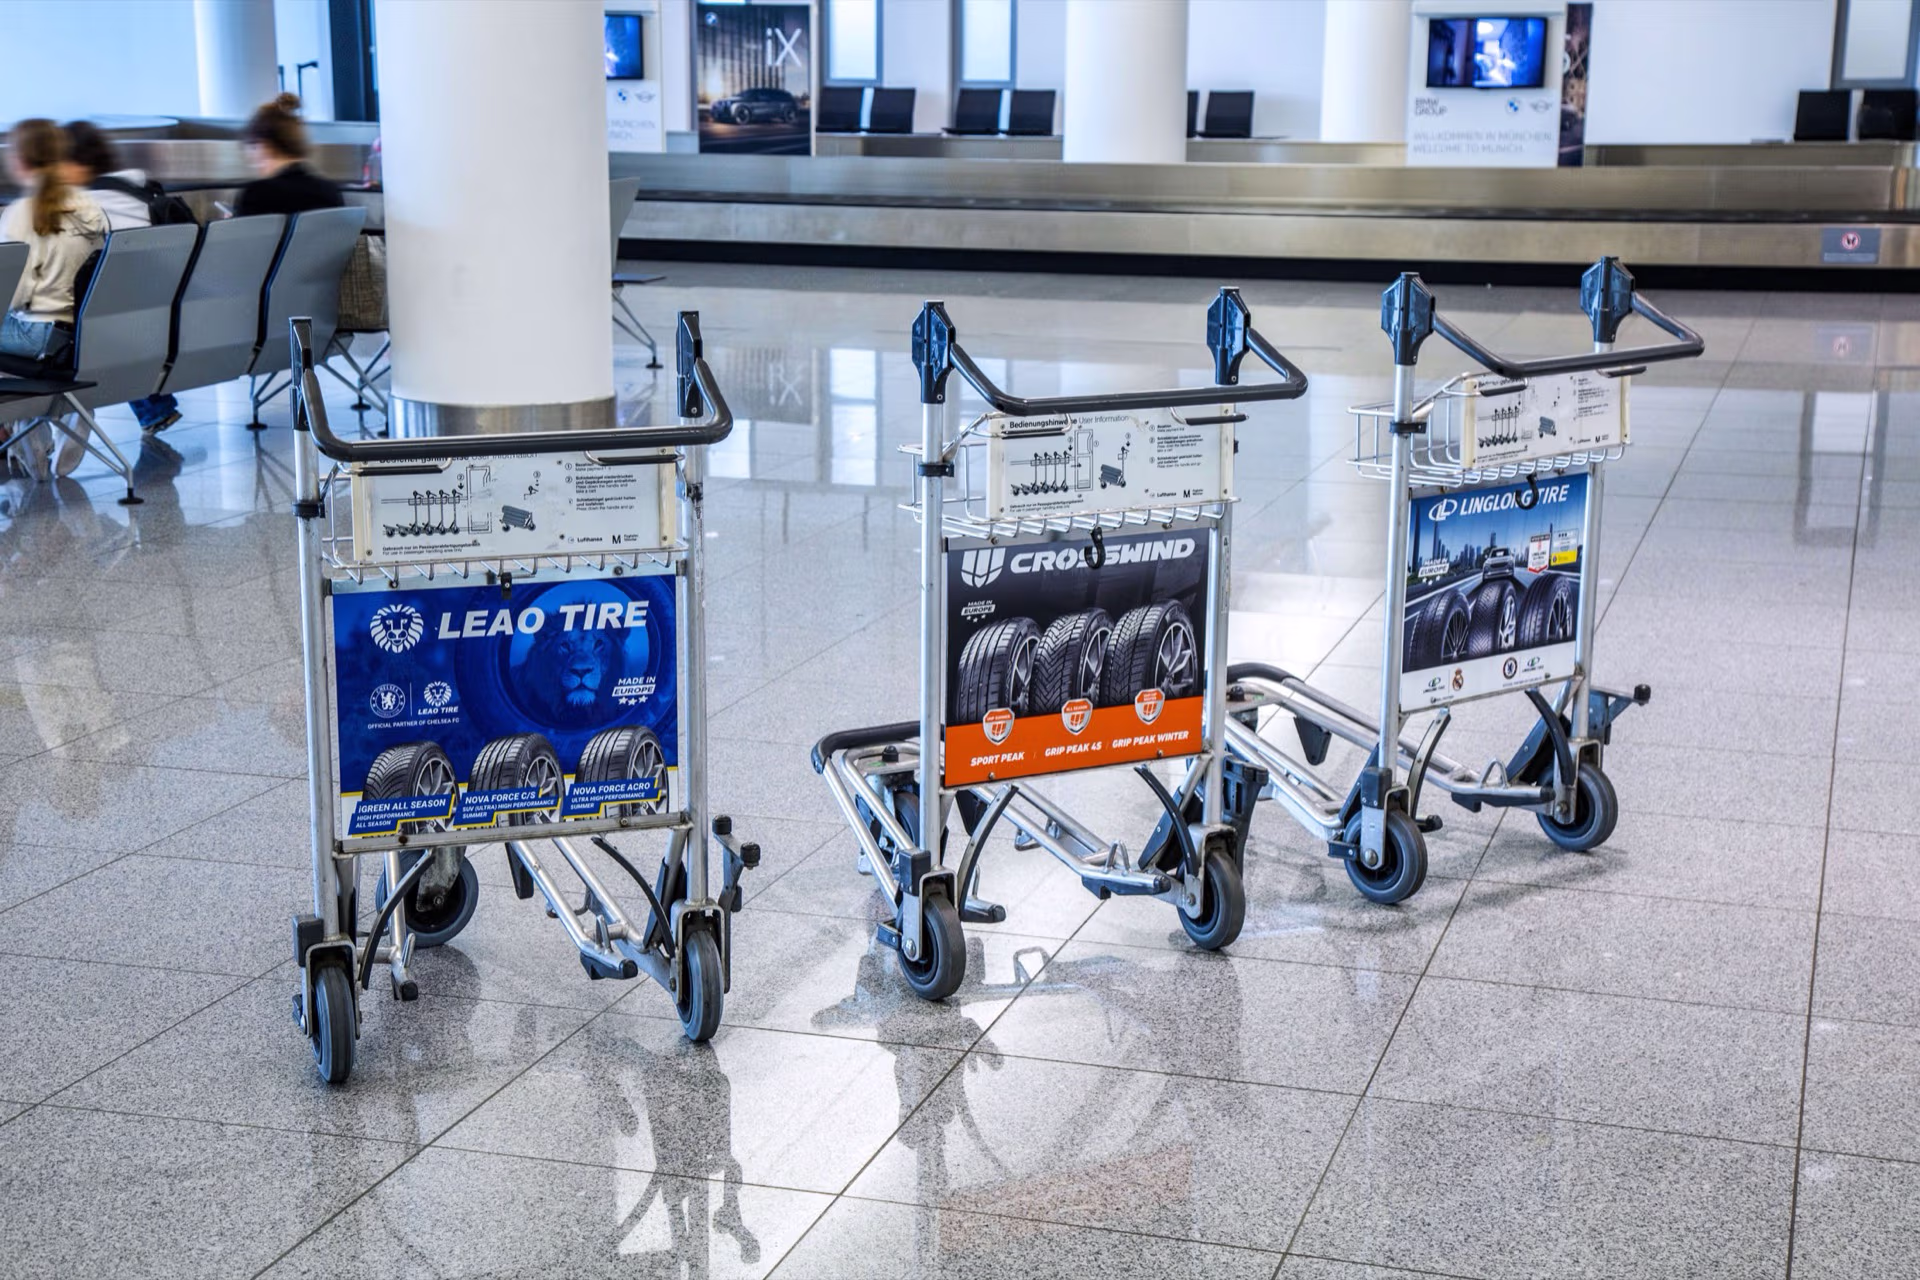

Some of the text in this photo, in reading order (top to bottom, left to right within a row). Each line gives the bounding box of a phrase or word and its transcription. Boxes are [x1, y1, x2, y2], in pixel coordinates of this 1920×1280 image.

[766, 28, 802, 67] iX
[1009, 413, 1129, 429] Bedienungshinwese User Information
[1183, 489, 1191, 498] M
[612, 534, 621, 544] M
[1420, 565, 1448, 576] EUROPE
[963, 605, 993, 615] EUROPE
[438, 600, 650, 640] LEAO TIRE
[618, 676, 656, 686] MADE IN
[614, 686, 654, 696] EUROPE
[417, 706, 459, 716] LEAO TIRE
[367, 722, 392, 730] OFFICIAL
[393, 720, 418, 728] PARTNER
[426, 717, 451, 725] CHELSEA
[452, 716, 460, 724] FC
[1112, 731, 1189, 748] GRIP PEAK WINTER
[1045, 741, 1102, 757] GRIP PEAK 4S
[970, 751, 1025, 767] SPORT PEAK
[573, 781, 650, 795] NOVA FORCE ACRO
[465, 790, 536, 805] NOVA FORCE C/S
[589, 794, 604, 802] HIGH
[604, 791, 645, 801] PERFORMANCE
[391, 802, 410, 811] ALL
[410, 799, 446, 809] SEASON
[512, 799, 554, 808] PERFORMANCE
[570, 802, 594, 810] SUMMER
[372, 811, 416, 820] PERFORMANCE
[462, 811, 487, 819] SUMMER
[367, 820, 391, 828] SEASON
